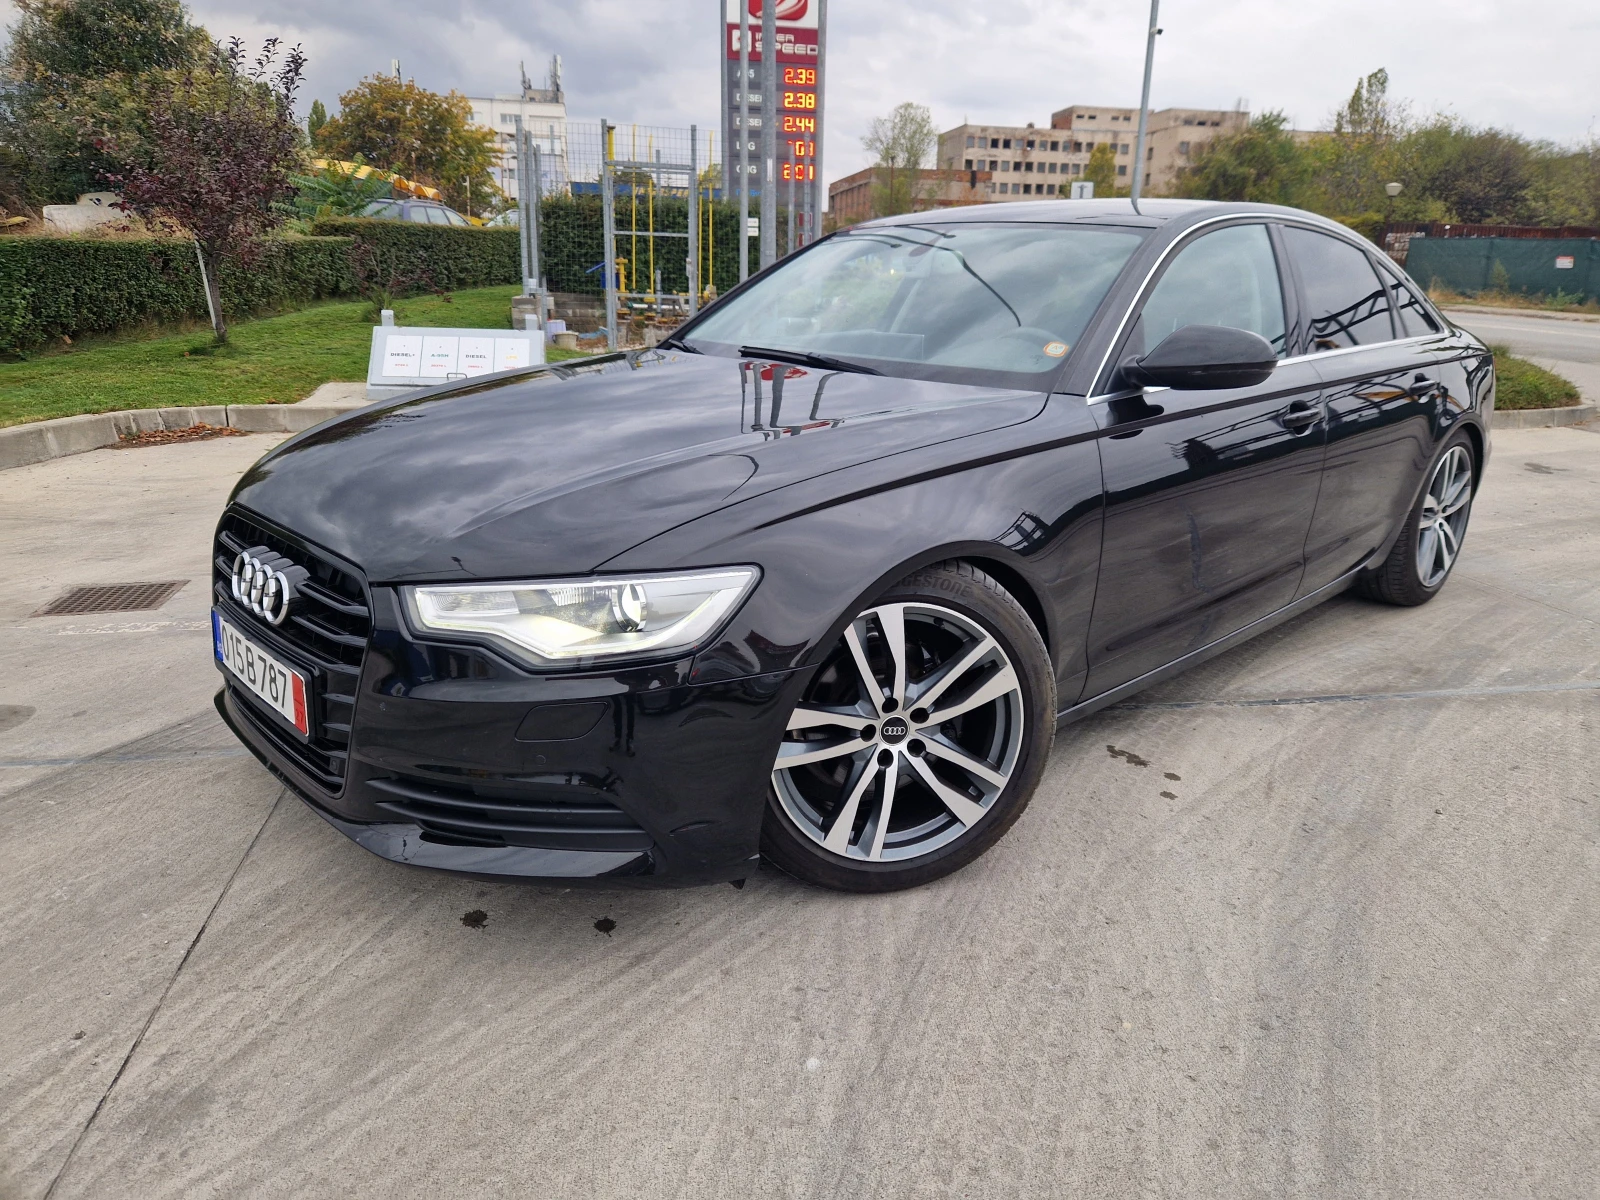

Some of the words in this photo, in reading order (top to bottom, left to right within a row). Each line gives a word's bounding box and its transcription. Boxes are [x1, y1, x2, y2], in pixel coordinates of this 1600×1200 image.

[755, 32, 794, 43] IER
[784, 68, 816, 84] 2.39
[736, 93, 762, 103] DSE
[784, 92, 815, 108] 2.38
[784, 116, 815, 132] 2.44
[736, 141, 755, 150] LG
[736, 165, 757, 174] CG
